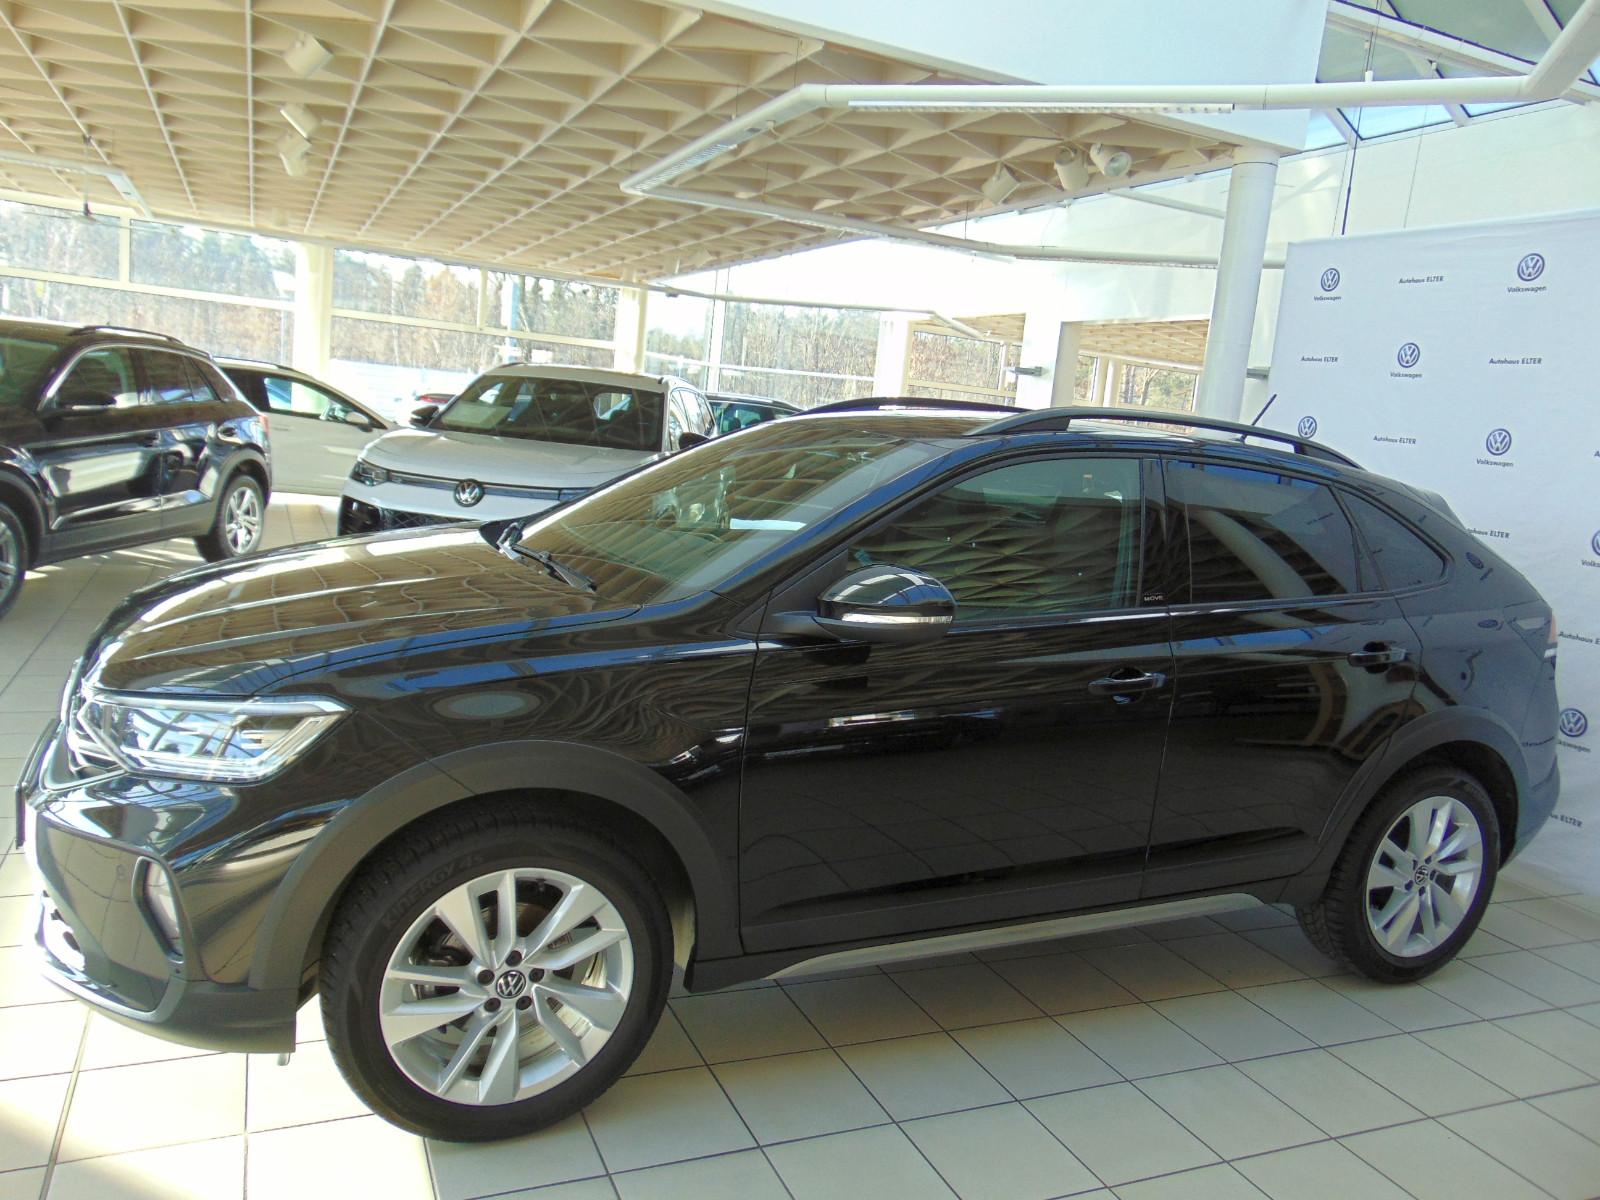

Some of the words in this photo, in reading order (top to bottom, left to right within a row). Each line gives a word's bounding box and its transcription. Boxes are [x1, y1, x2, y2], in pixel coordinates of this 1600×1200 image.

[1426, 275, 1444, 283] ELTER
[1507, 285, 1547, 293] Volkswagen
[1488, 357, 1520, 365] Autohaus
[1521, 357, 1543, 365] ELTER
[1390, 371, 1423, 379] Volkswagen
[1372, 434, 1398, 443] Autohaus
[1476, 458, 1514, 468] Volkswagen
[1489, 530, 1511, 539] ELTER
[1557, 631, 1594, 644] Autohaus
[1559, 813, 1583, 828] ELTER
